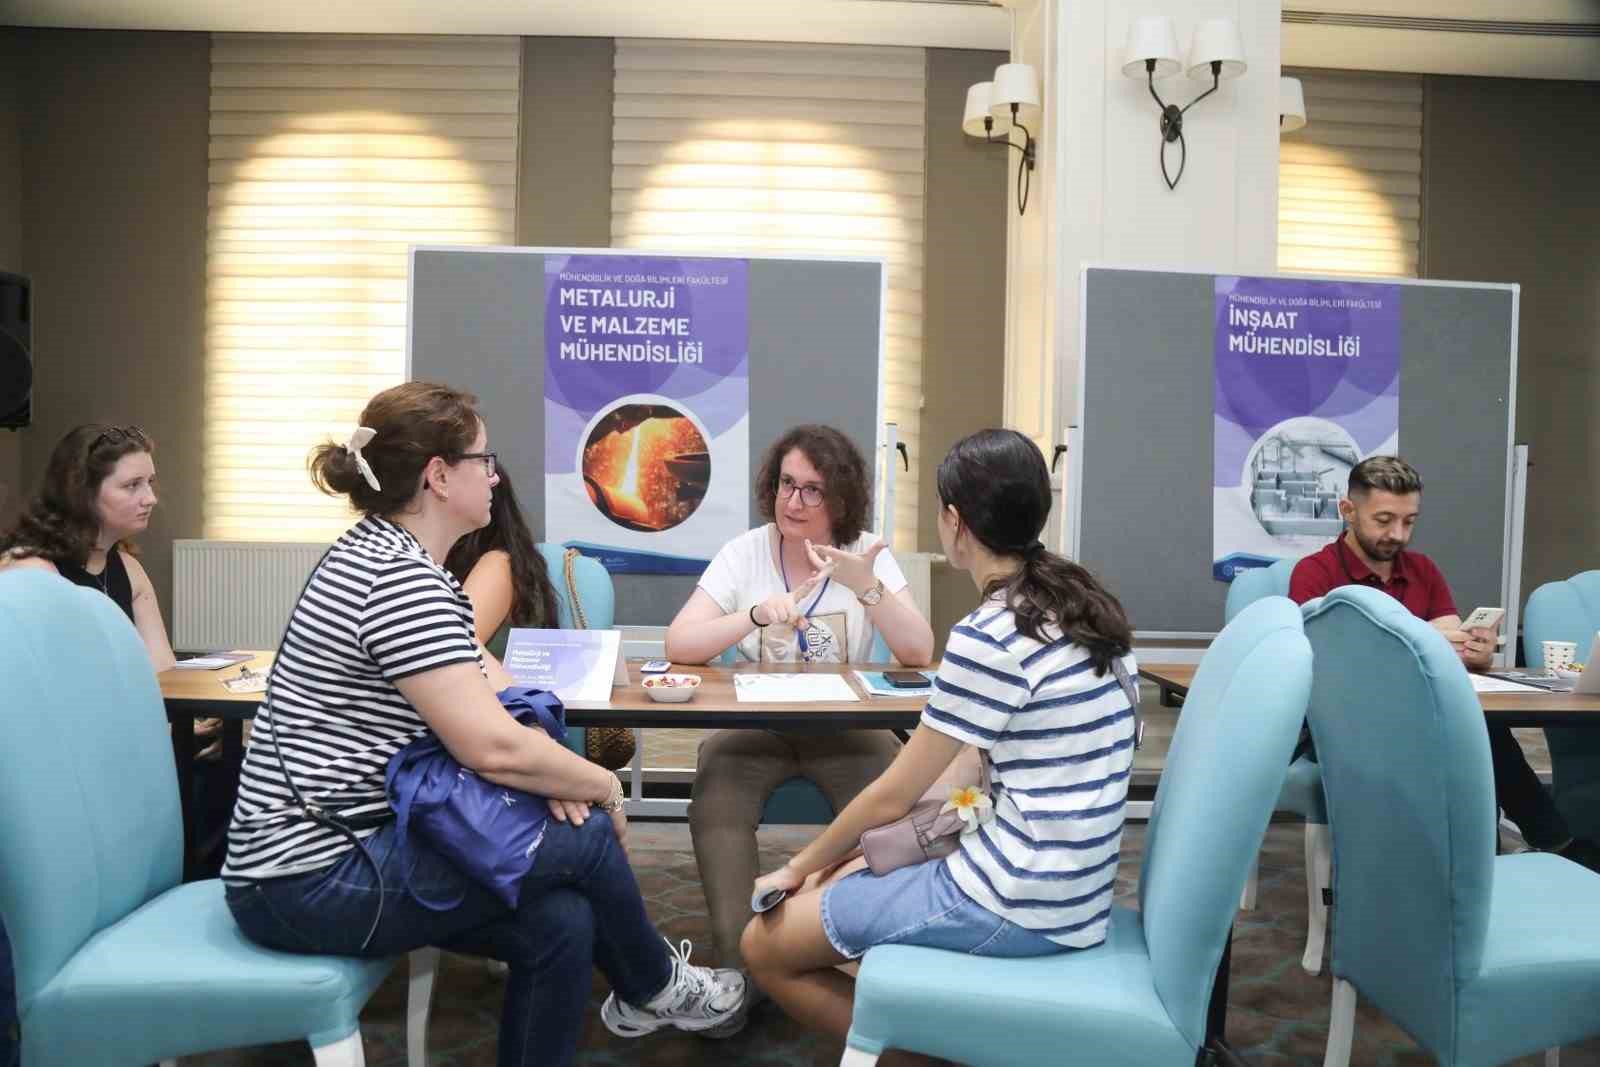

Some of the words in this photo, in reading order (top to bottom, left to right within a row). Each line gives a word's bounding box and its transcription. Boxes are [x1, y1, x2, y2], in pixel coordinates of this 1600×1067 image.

[559, 286, 675, 309] METALURJİ
[559, 315, 587, 334] VE
[591, 316, 690, 336] MALZEME
[1229, 304, 1298, 332] İNŞAAT
[559, 338, 704, 364] MÜHENDİSLİĞİ
[1229, 331, 1360, 358] MÜHENDİSLİĞİ
